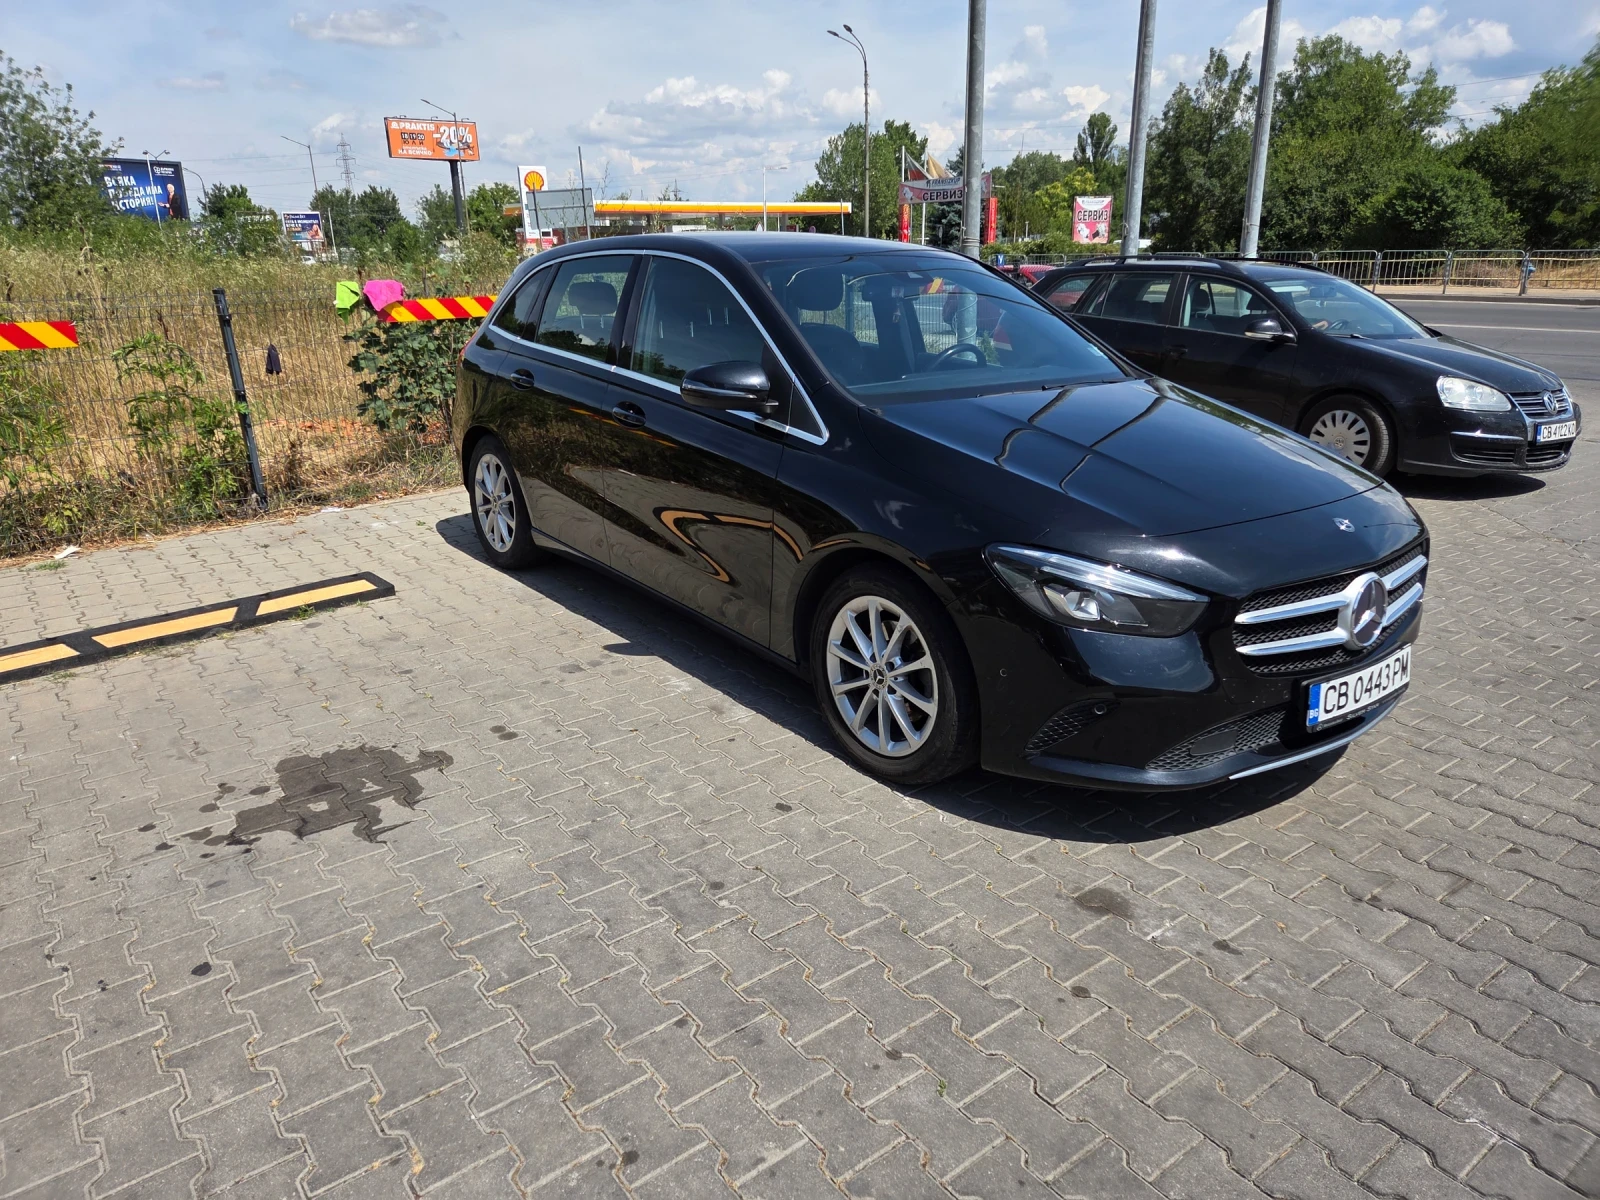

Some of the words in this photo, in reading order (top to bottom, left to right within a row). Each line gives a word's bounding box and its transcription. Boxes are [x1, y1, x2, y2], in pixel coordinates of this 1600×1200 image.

[399, 122, 434, 131] PRAKTIS
[433, 126, 472, 143] -20%
[104, 175, 136, 188] ВСЯКА
[922, 189, 963, 201] СЕРВИЗ
[1077, 209, 1108, 221] СЕРВИЗ
[1323, 681, 1349, 714] CB
[1353, 663, 1391, 704] 0443
[1392, 651, 1409, 686] PM
[1309, 709, 1319, 718] BG
